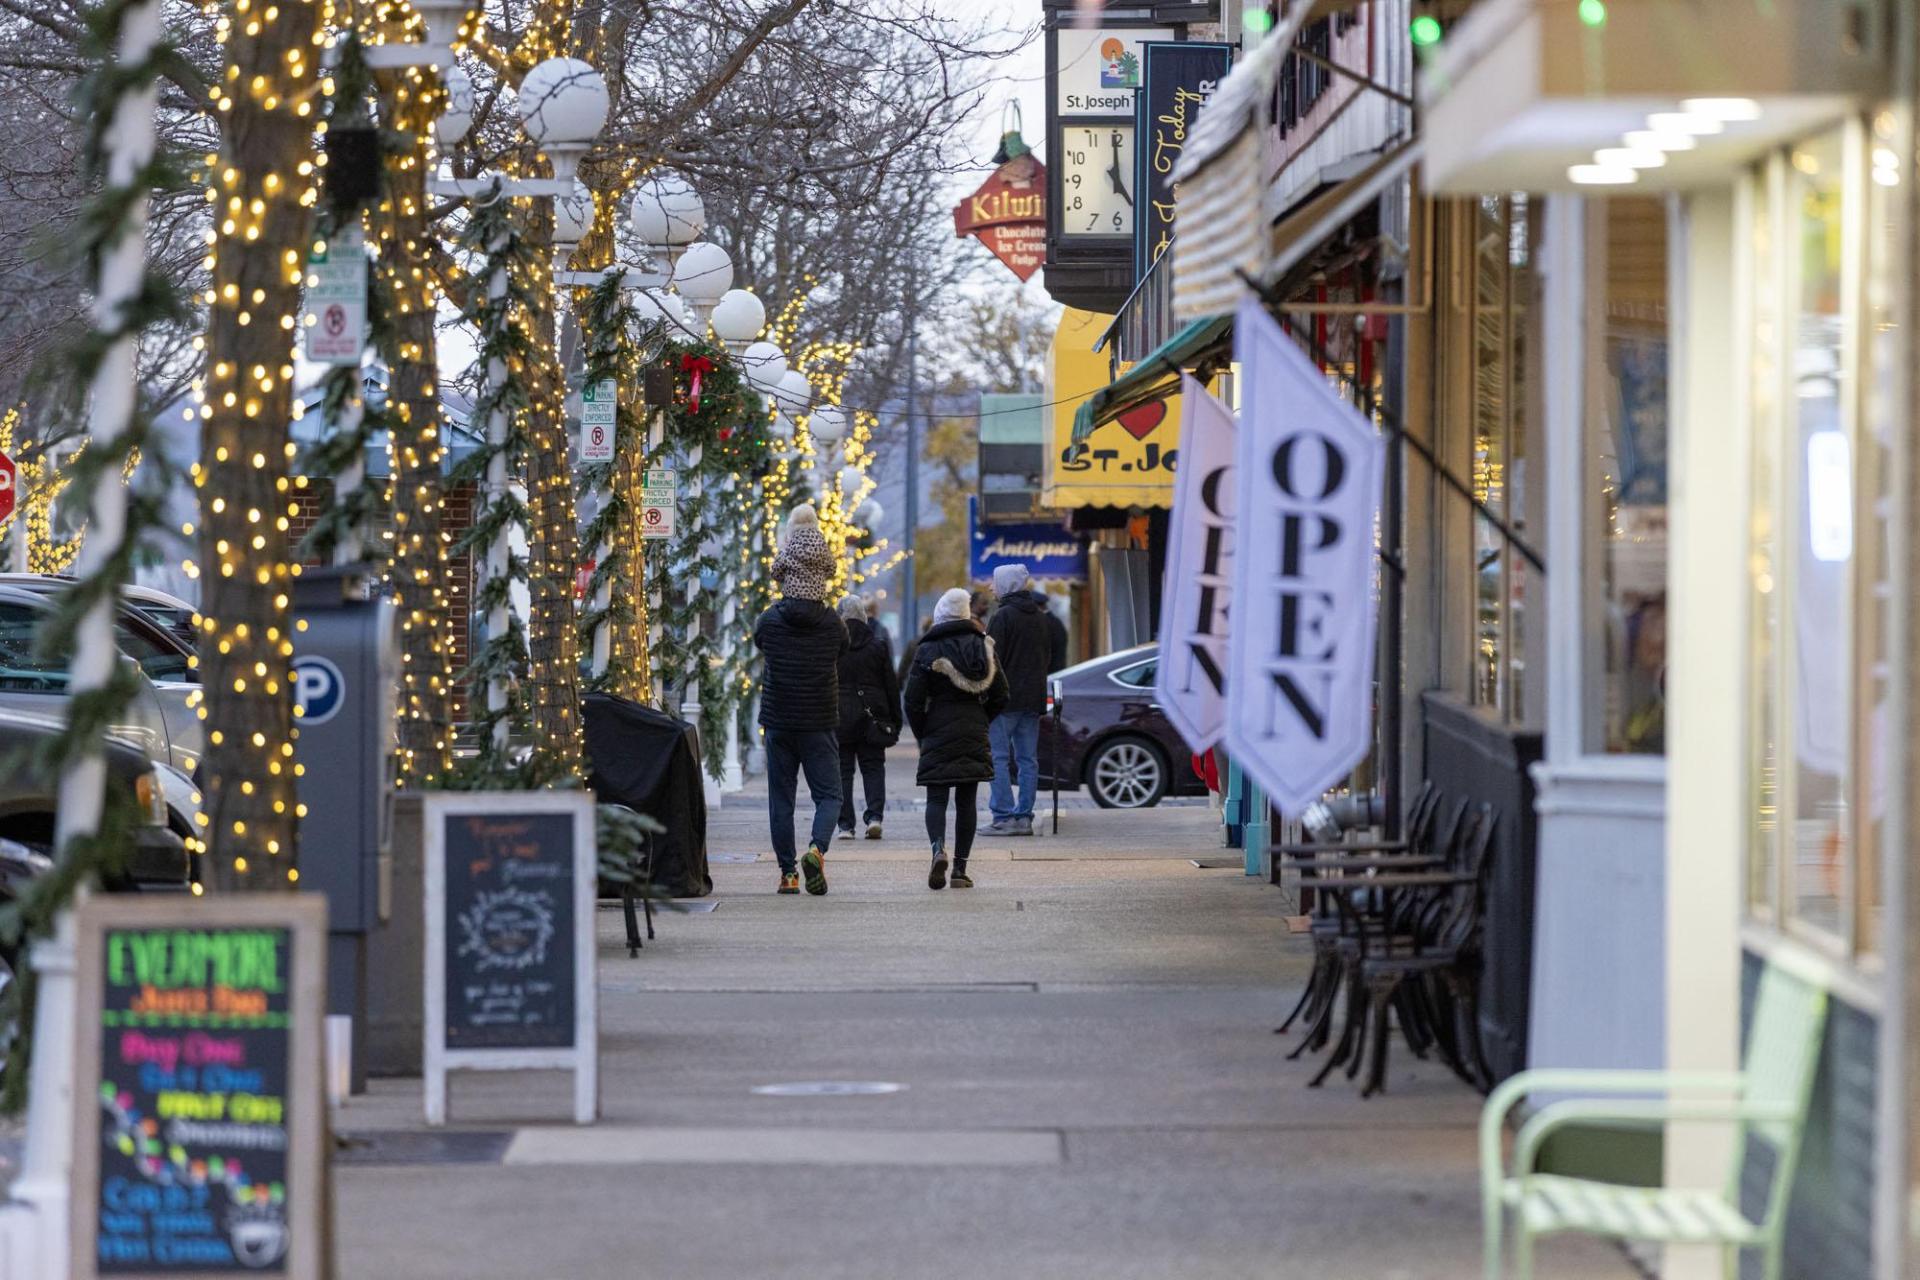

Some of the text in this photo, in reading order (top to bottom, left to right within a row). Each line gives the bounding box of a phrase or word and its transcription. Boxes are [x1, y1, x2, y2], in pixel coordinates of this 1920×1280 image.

[1072, 151, 1085, 165] 10
[1071, 174, 1082, 189] 9
[971, 190, 1046, 223] Kilwi
[1073, 196, 1083, 209] 8
[1090, 213, 1100, 227] 7
[1112, 211, 1123, 226] 6
[587, 404, 610, 412] STRICTLY
[585, 413, 612, 422] ENFORCED
[643, 489, 668, 497] TRICTLY
[979, 534, 1079, 562] Antiques
[1264, 430, 1349, 742] OPEN
